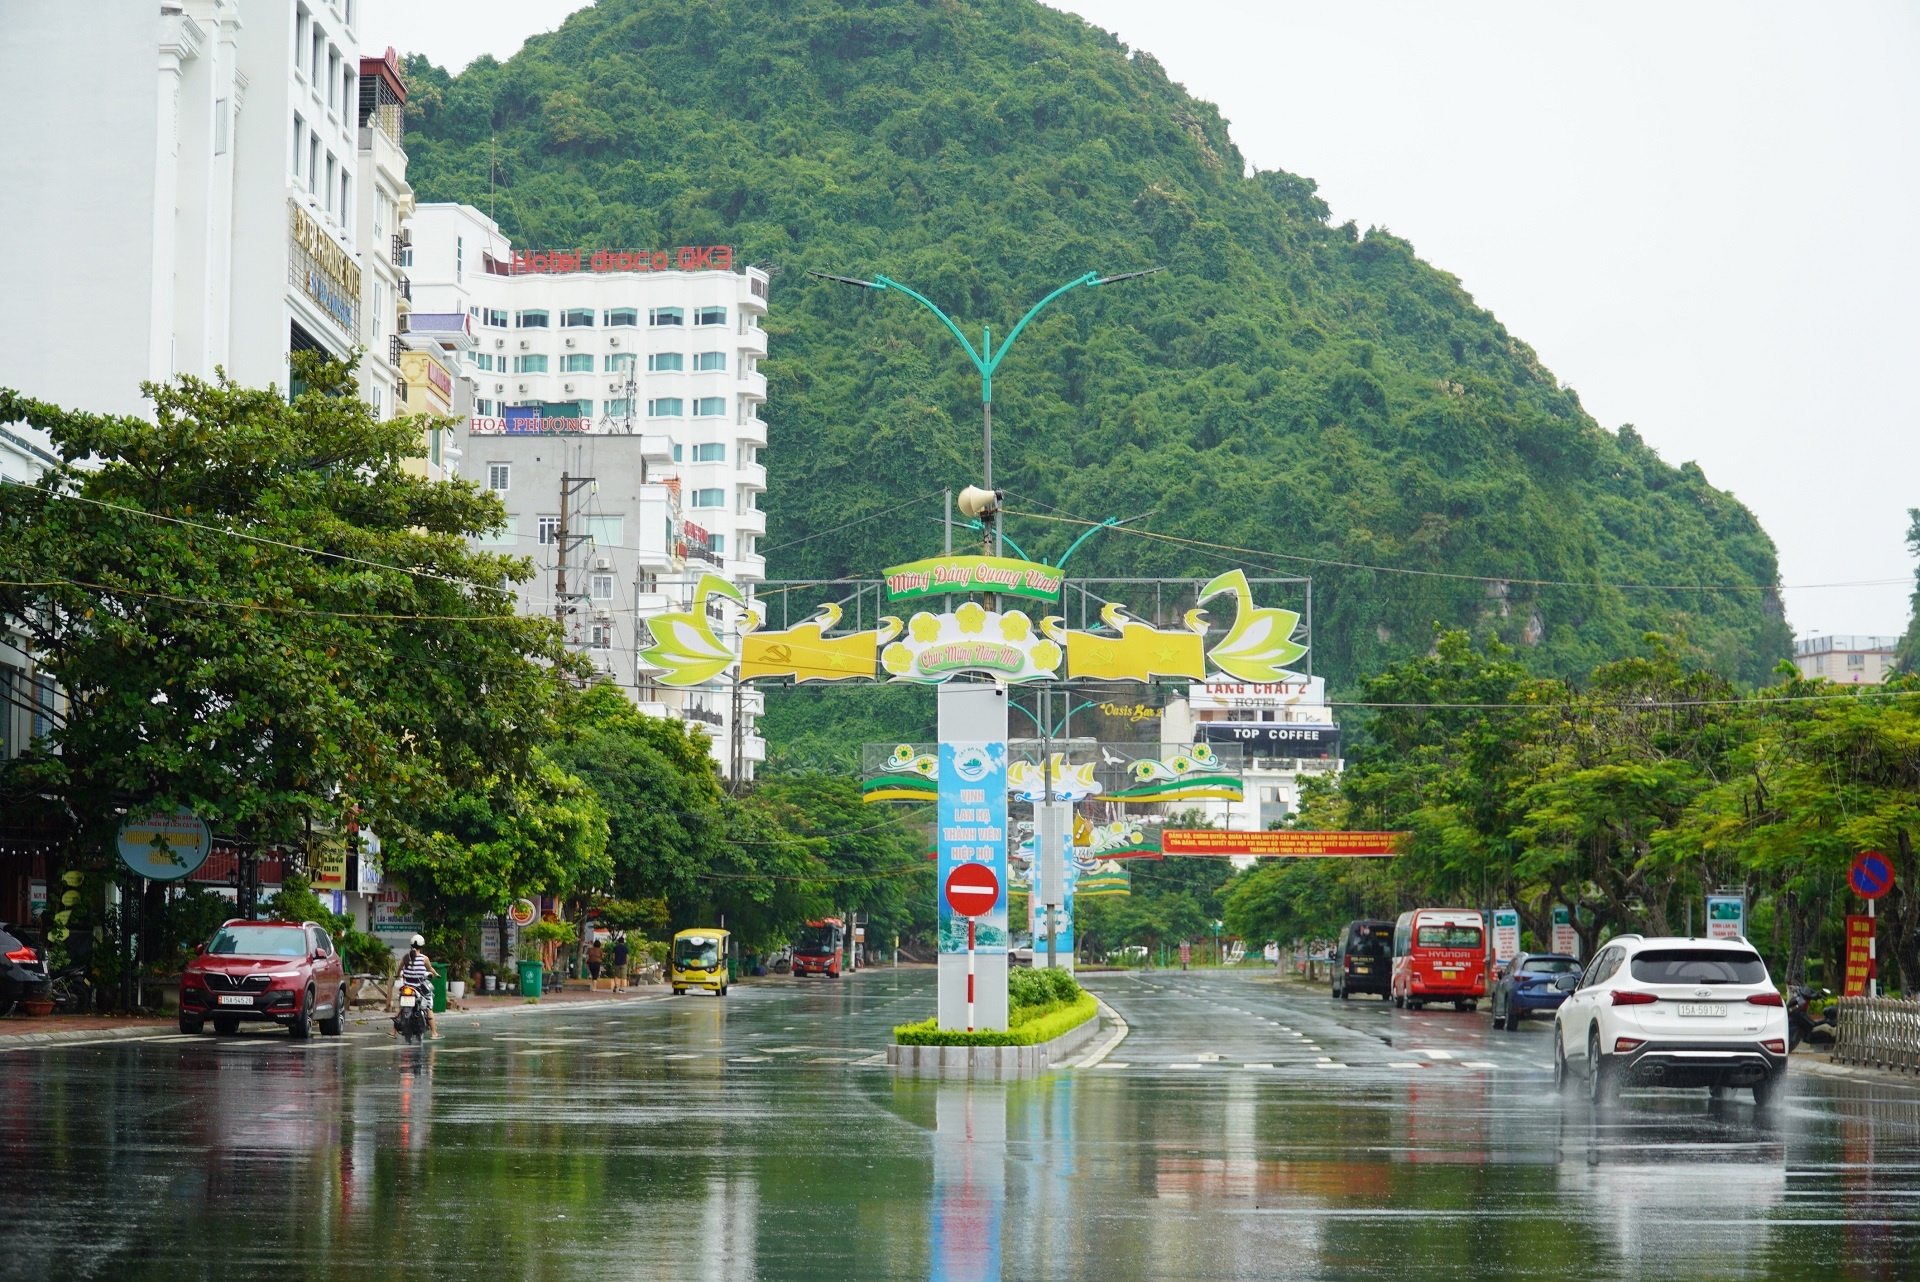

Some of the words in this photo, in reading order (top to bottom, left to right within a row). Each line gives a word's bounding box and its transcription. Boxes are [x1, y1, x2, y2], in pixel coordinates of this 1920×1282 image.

[512, 248, 581, 273] Hotel
[590, 248, 668, 272] draco
[677, 245, 733, 270] QK3
[471, 418, 507, 431] HOA
[513, 416, 592, 434] PHƯỢNG
[887, 571, 930, 594] Mừng
[934, 564, 972, 588] Đảng
[975, 563, 1022, 590] Quang
[1025, 570, 1060, 594] Vinh
[920, 651, 943, 669] Chúc
[945, 646, 973, 666] Mừng
[975, 643, 998, 662] Năm
[999, 647, 1022, 668] Mới
[1298, 683, 1306, 694] 2
[1234, 697, 1279, 707] HOTEL
[1104, 703, 1133, 716] Oasis
[1131, 704, 1154, 722] Bar
[1233, 728, 1260, 739] TOP
[1268, 729, 1320, 741] COFFEE
[960, 789, 985, 805] VỊNH
[955, 808, 974, 822] LAN
[976, 808, 991, 825] HẠ
[943, 825, 976, 841] THÀNH
[978, 826, 1001, 841] VIÊN
[951, 844, 975, 863] HIỆP
[976, 845, 994, 863] HỘI
